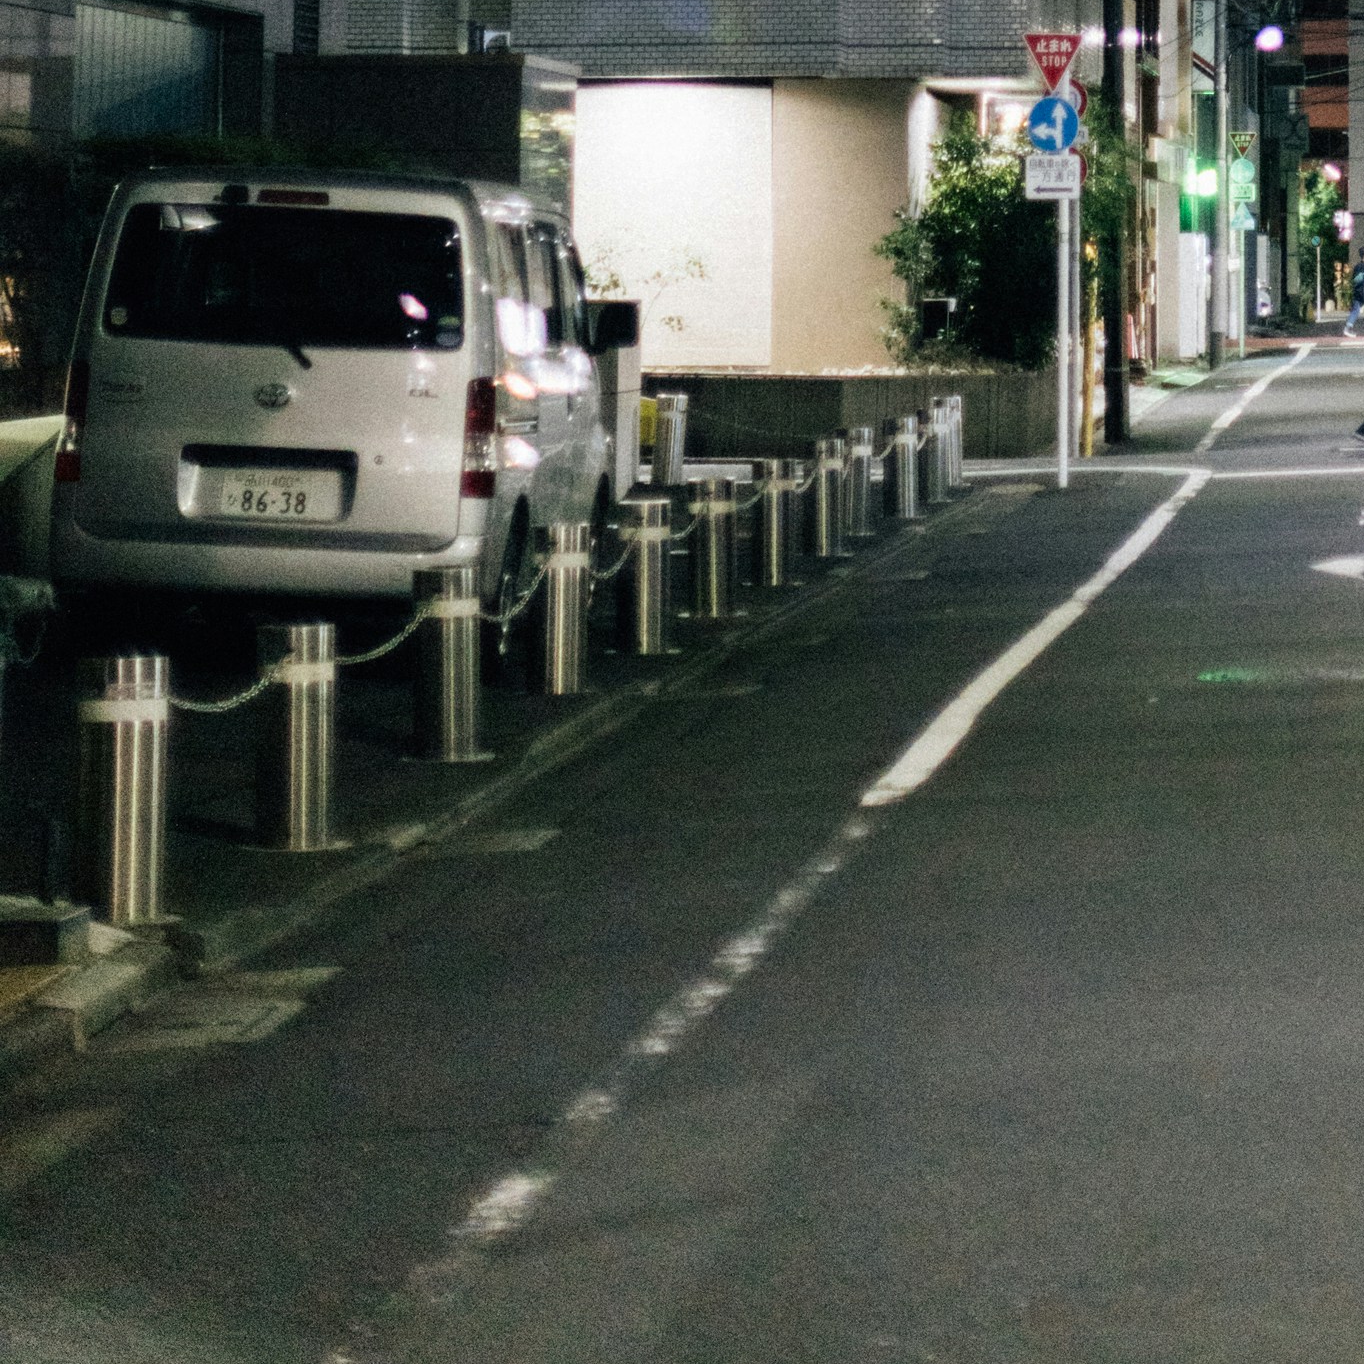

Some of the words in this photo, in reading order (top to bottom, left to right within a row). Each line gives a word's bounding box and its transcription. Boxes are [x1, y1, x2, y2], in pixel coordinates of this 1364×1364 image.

[1035, 38, 1072, 53] 止まれ
[1041, 55, 1067, 67] STOP
[1029, 170, 1077, 183] 一方通行
